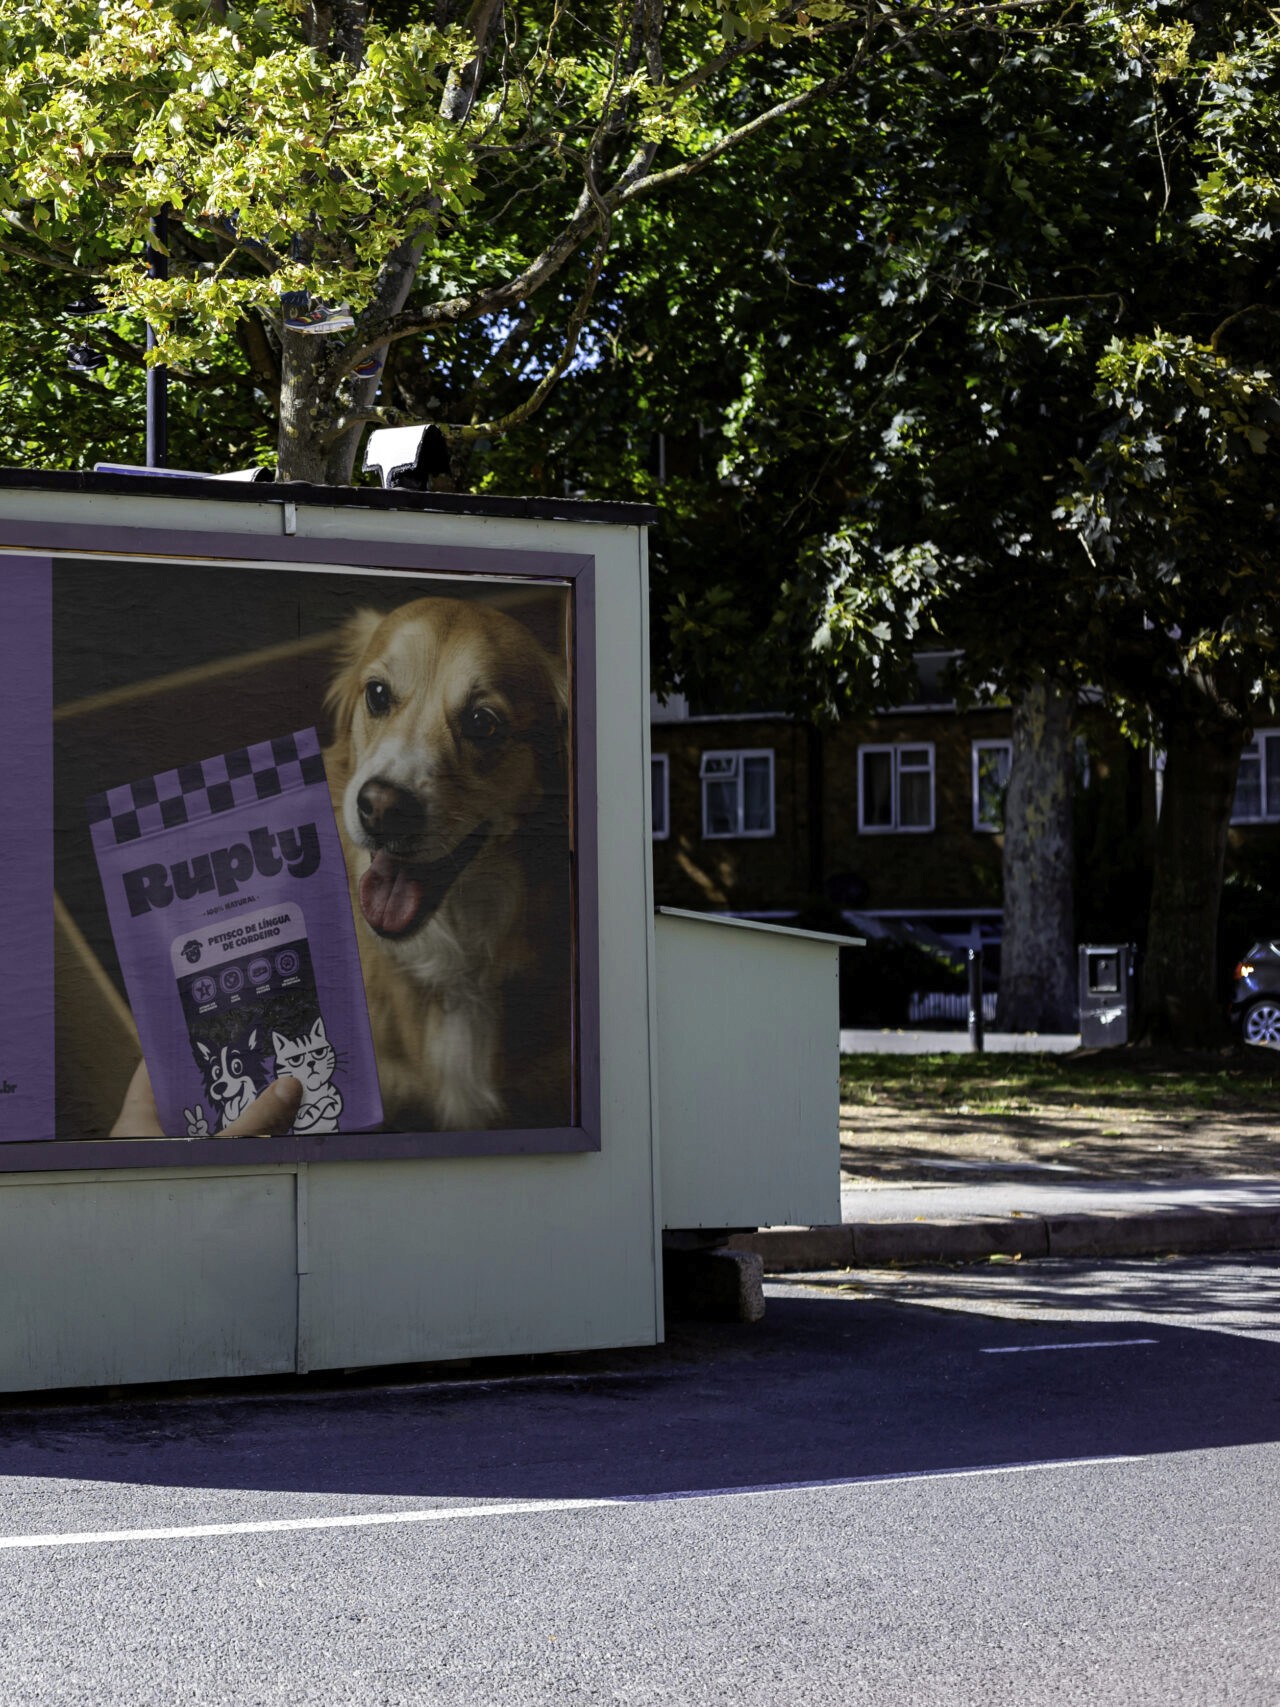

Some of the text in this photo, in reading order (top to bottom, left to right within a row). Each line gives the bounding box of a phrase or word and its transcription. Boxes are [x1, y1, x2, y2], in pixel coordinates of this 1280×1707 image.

[123, 823, 321, 918] Rupty
[208, 914, 291, 946] PETISCO DE LÍNGUA
[223, 928, 280, 951] DE CORDEIRO
